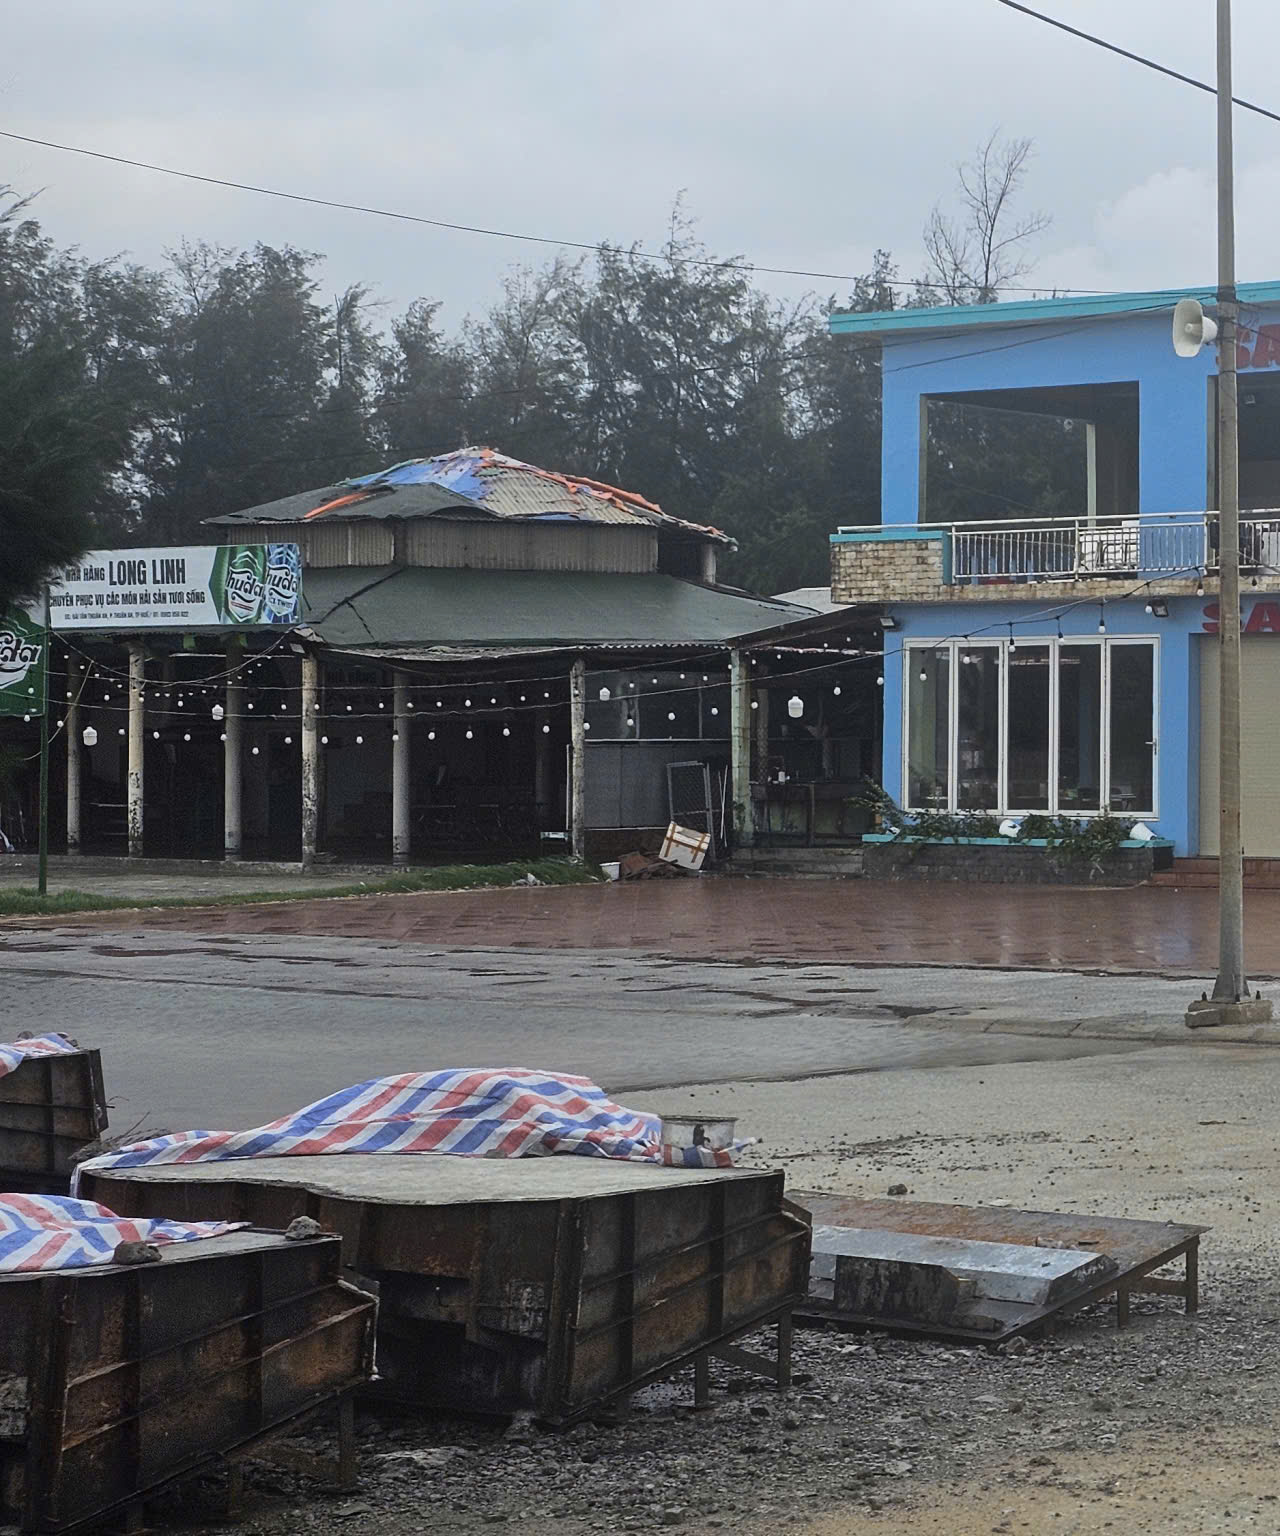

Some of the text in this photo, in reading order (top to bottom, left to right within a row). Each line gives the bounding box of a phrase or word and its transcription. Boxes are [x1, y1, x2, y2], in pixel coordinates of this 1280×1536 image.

[83, 565, 105, 581] HÀNG
[109, 560, 147, 586] LONG
[152, 559, 186, 584] LINH
[225, 567, 264, 598] huda
[76, 594, 93, 608] PHỤC
[95, 594, 104, 608] VỤ
[106, 591, 120, 606] CÁC
[121, 591, 137, 605] MÓN
[153, 589, 167, 604] SẢN
[186, 589, 205, 604] SỐNG
